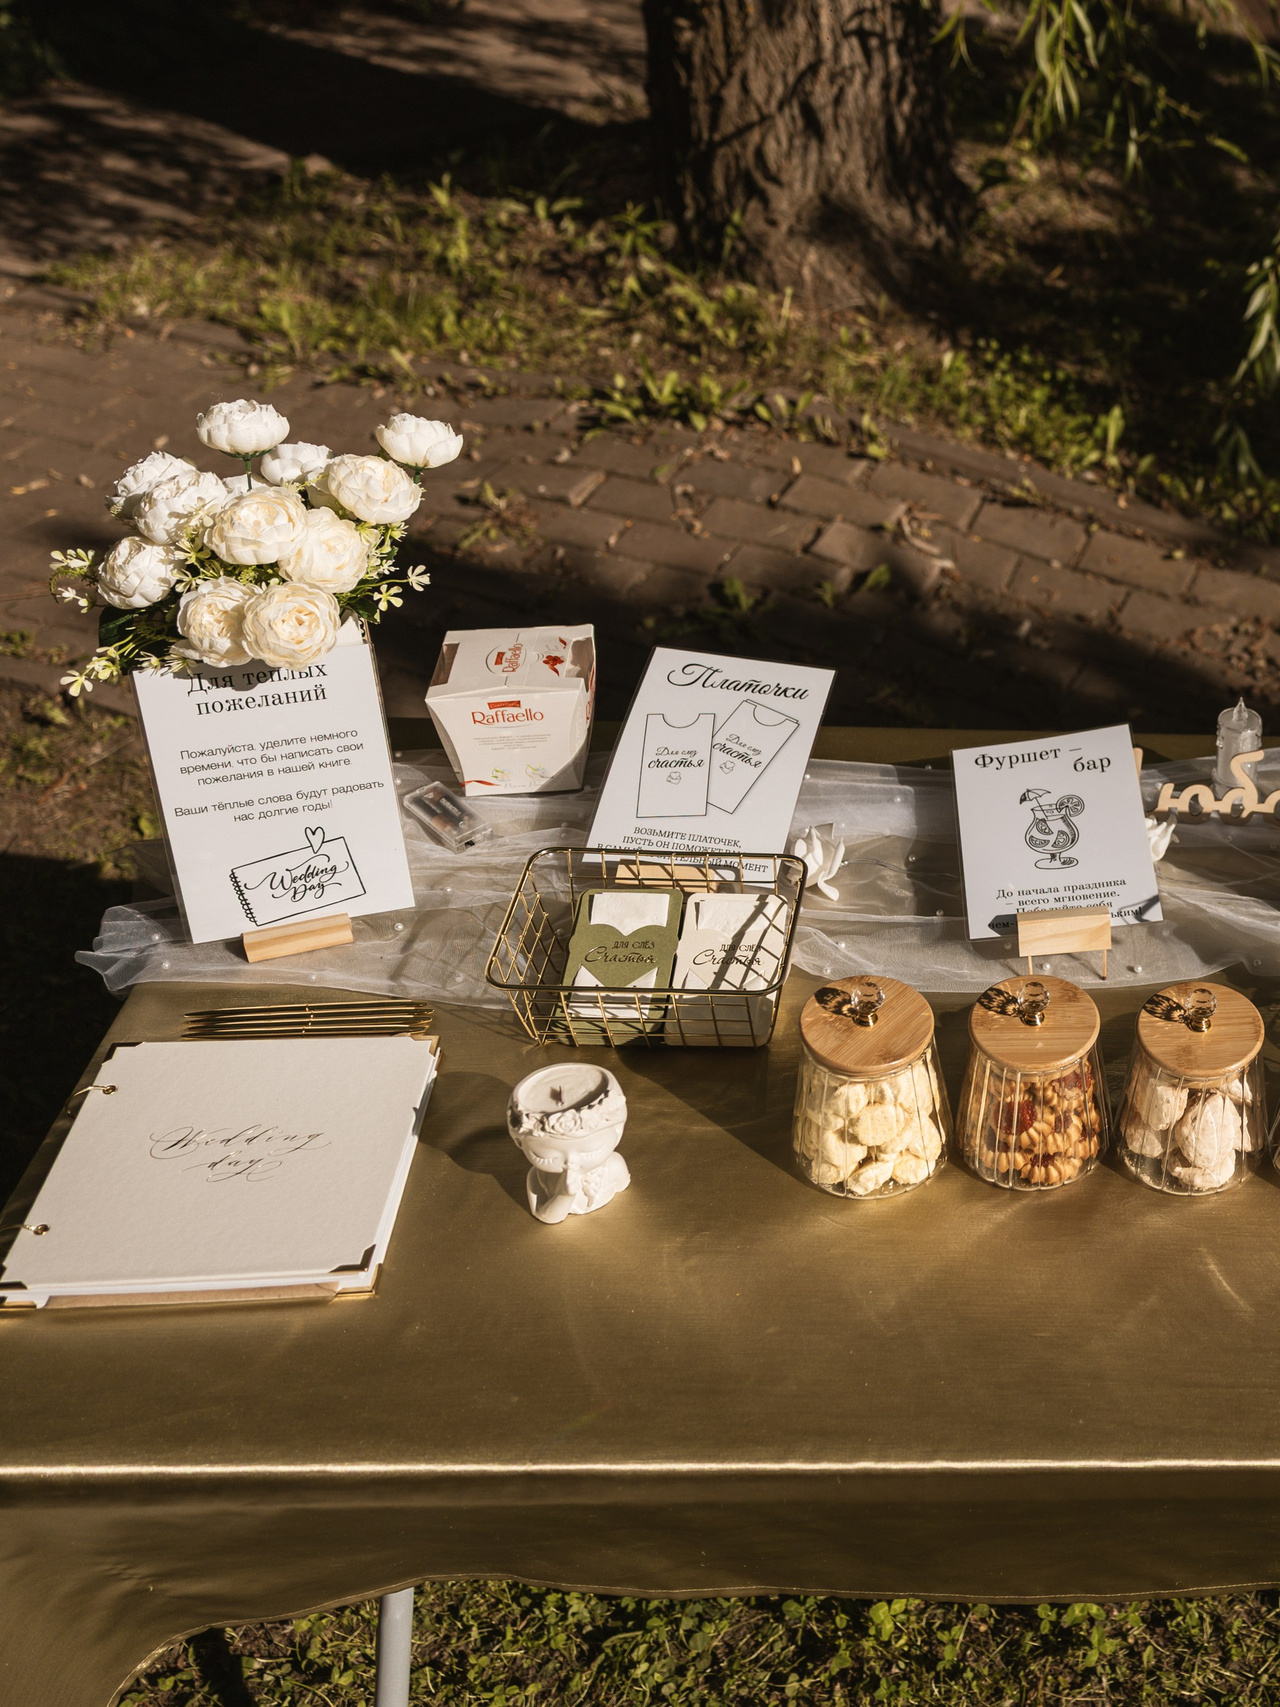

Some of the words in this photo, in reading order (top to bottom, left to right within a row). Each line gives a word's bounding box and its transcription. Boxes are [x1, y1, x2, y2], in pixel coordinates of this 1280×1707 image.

[501, 643, 523, 673] Raffaello
[187, 672, 235, 697] Для
[666, 663, 811, 701] Платочки
[196, 684, 328, 715] пожеланий
[472, 709, 544, 727] Raffaello
[259, 735, 307, 756] уделите
[310, 729, 358, 744] немного
[655, 746, 680, 756] Для
[726, 733, 748, 748] Для
[237, 755, 257, 767] что
[260, 751, 277, 764] бы
[280, 747, 333, 762] написать
[336, 741, 364, 754] свои
[647, 757, 705, 769] счастья
[712, 742, 762, 769] счастья
[974, 745, 1061, 771] Фуршет
[1073, 753, 1112, 775] бар
[197, 769, 263, 786] пожелания
[267, 767, 275, 777] в
[278, 760, 315, 776] нашей
[174, 804, 208, 818] Ваши
[211, 797, 255, 814] тёплые
[258, 792, 293, 806] слова
[296, 787, 329, 804] будут
[332, 781, 385, 798] радовать
[233, 811, 255, 823] нас
[258, 806, 299, 822] долгие
[302, 799, 333, 813] годы!
[622, 836, 654, 847] ПУСТЬ
[655, 840, 670, 849] ОН
[633, 827, 686, 841] ВОЗЬМИТЕ
[687, 833, 742, 849] ПЛАТОЧЕК,
[244, 854, 350, 892] Wedding
[727, 860, 768, 873] МОМЕНТ
[271, 881, 342, 902] Day
[996, 889, 1013, 900] До
[1017, 886, 1059, 897] начала
[1064, 879, 1127, 894] праздника
[1018, 897, 1049, 907] всего
[1053, 890, 1121, 904] мгновение.
[584, 945, 657, 966] Счастья
[612, 940, 633, 950] ДЛЯ
[692, 950, 763, 967] Счастья
[149, 1124, 332, 1160] Wedding
[178, 1151, 283, 1182] day
